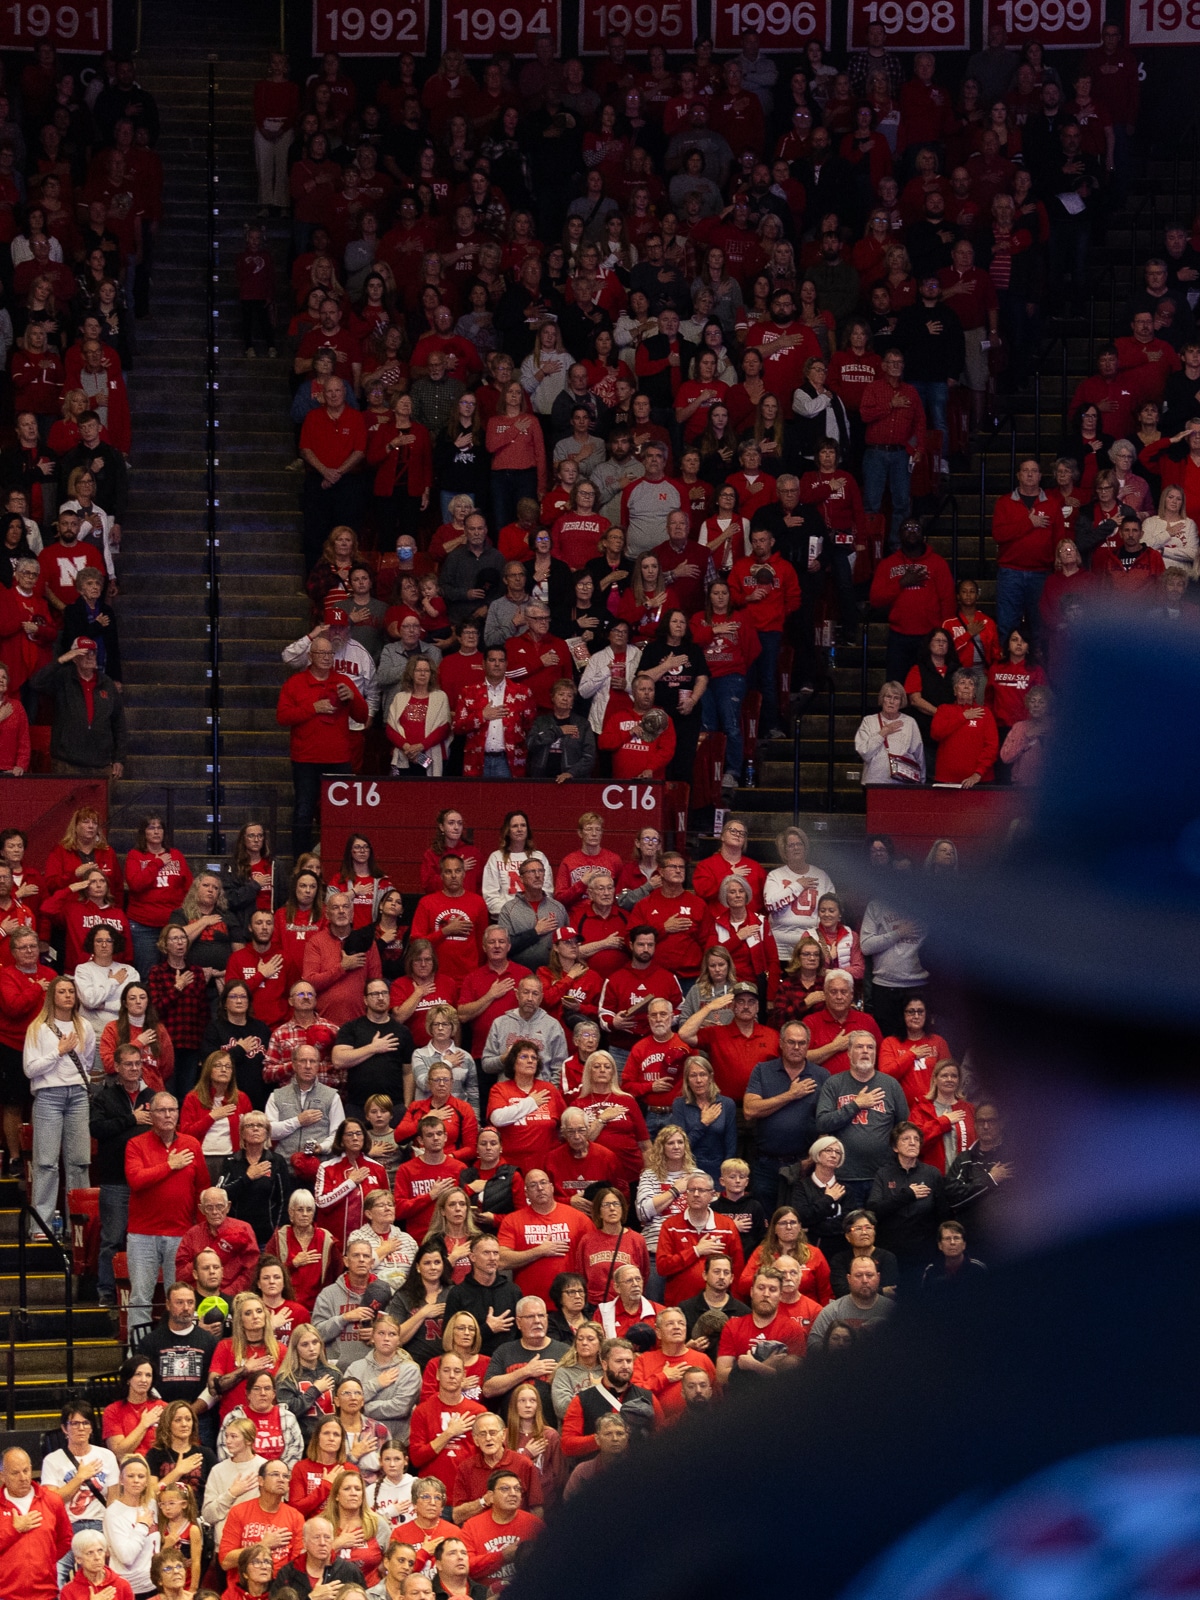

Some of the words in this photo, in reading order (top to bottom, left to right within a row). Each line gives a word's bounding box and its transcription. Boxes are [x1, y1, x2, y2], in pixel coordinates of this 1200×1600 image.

[6, 3, 100, 40] 1991
[326, 7, 418, 41] 1992
[453, 8, 552, 41] 1994
[592, 4, 683, 38] 1995
[724, 2, 817, 36] 1996
[862, 1, 957, 34] 1998
[996, 0, 1092, 33] 1999
[841, 364, 876, 376] NEBRASKA
[658, 493, 667, 501] N
[1109, 540, 1117, 548] N
[56, 555, 87, 587] N
[334, 611, 342, 621] N
[952, 626, 967, 639] N
[334, 659, 360, 676] ASKA
[781, 672, 789, 692] N
[994, 673, 1031, 682] NEBRASKA
[748, 718, 757, 739] N
[714, 761, 722, 781] N
[327, 781, 381, 807] C16
[601, 784, 657, 810] C16
[678, 811, 685, 832] N
[156, 876, 170, 888] N
[679, 905, 692, 915] N
[296, 931, 306, 940] N
[913, 1057, 927, 1071] N
[851, 1109, 869, 1124] N
[367, 1175, 379, 1185] N
[74, 1225, 84, 1248] N
[524, 1222, 571, 1235] NEBRASKA
[120, 1288, 130, 1306] N
[424, 1318, 445, 1341] N
[339, 1548, 352, 1559] N
